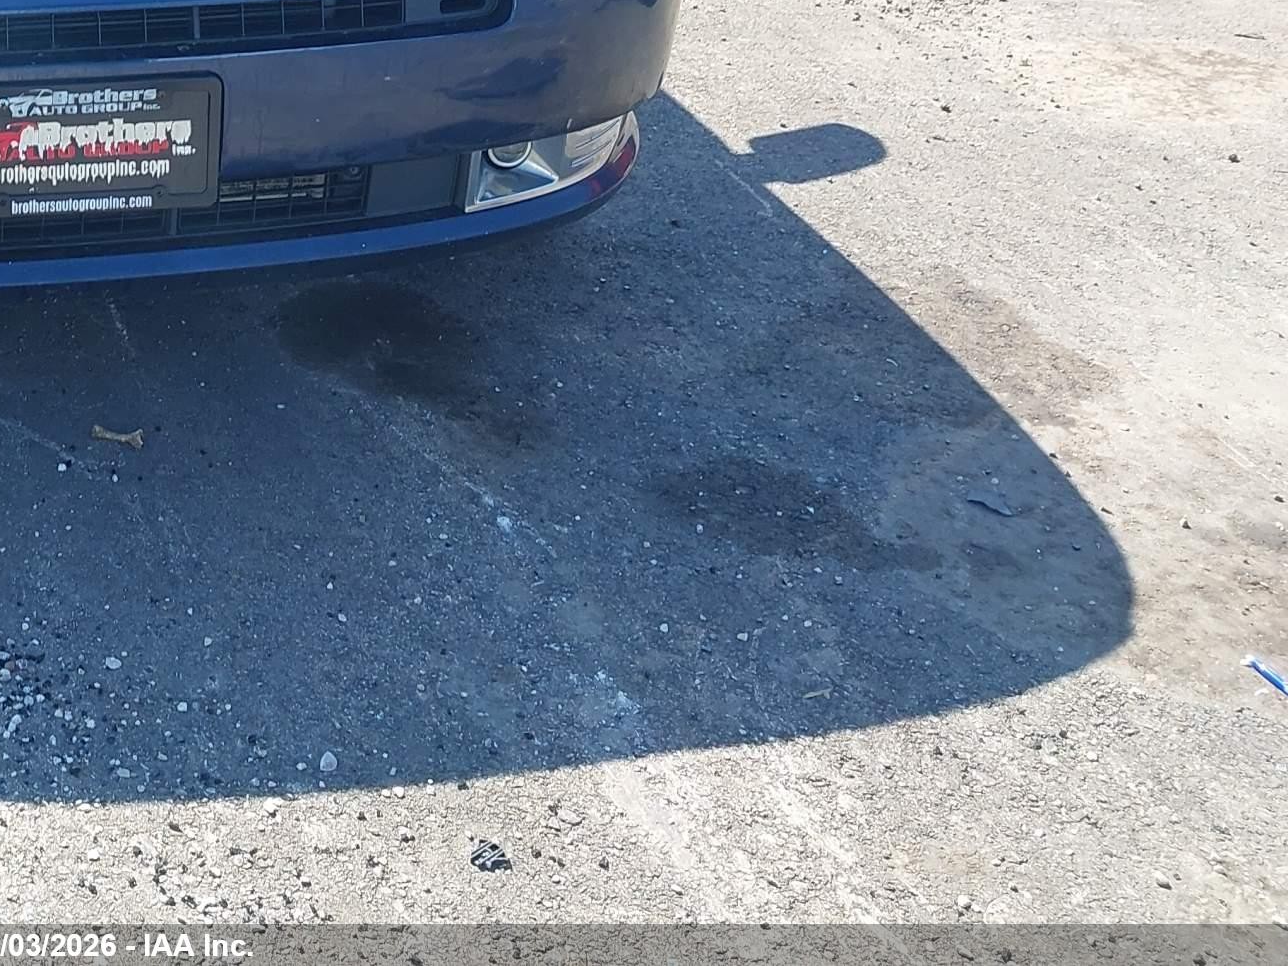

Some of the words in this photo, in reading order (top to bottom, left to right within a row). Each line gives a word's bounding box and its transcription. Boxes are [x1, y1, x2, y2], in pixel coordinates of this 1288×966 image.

[52, 88, 158, 105] Brothers
[28, 103, 78, 116] AUTO
[81, 102, 142, 115] GROUP
[38, 118, 192, 151] Brothers
